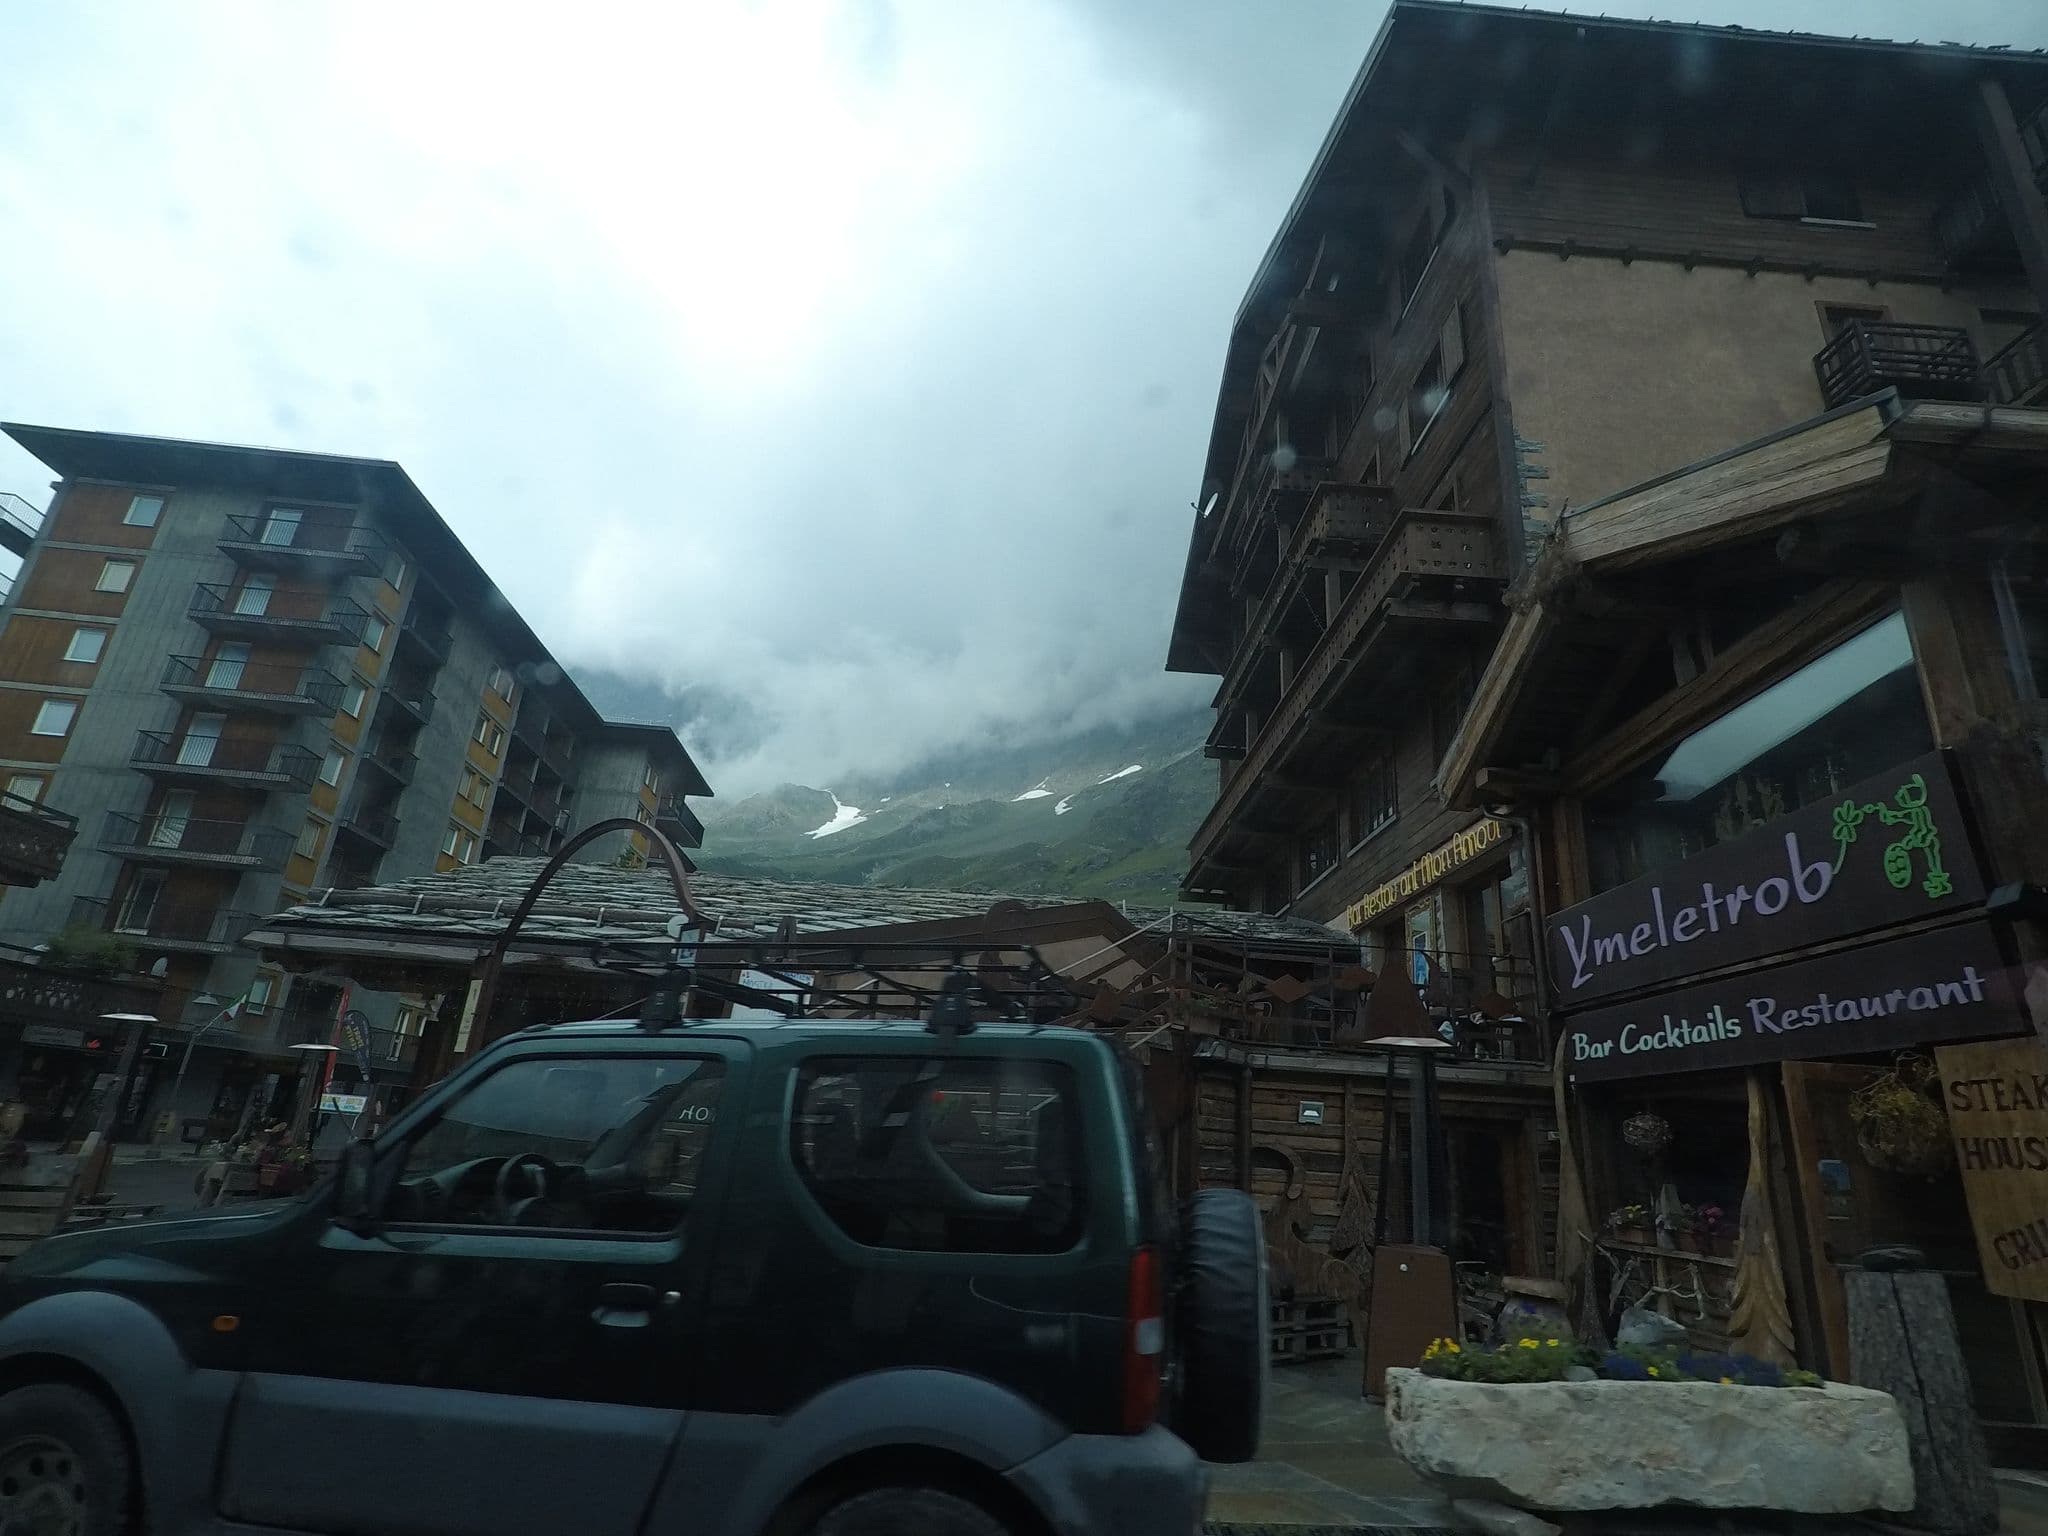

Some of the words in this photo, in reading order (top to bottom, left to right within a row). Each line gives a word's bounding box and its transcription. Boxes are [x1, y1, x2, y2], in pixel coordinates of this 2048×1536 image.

[1421, 849, 1452, 886] Mon
[1559, 832, 1834, 990] Ymeletrob
[1572, 1032, 1613, 1062] Bar
[1619, 1004, 1743, 1056] Cocktails
[1746, 966, 1986, 1036] Restaurant
[1960, 1136, 2048, 1171] HOUS
